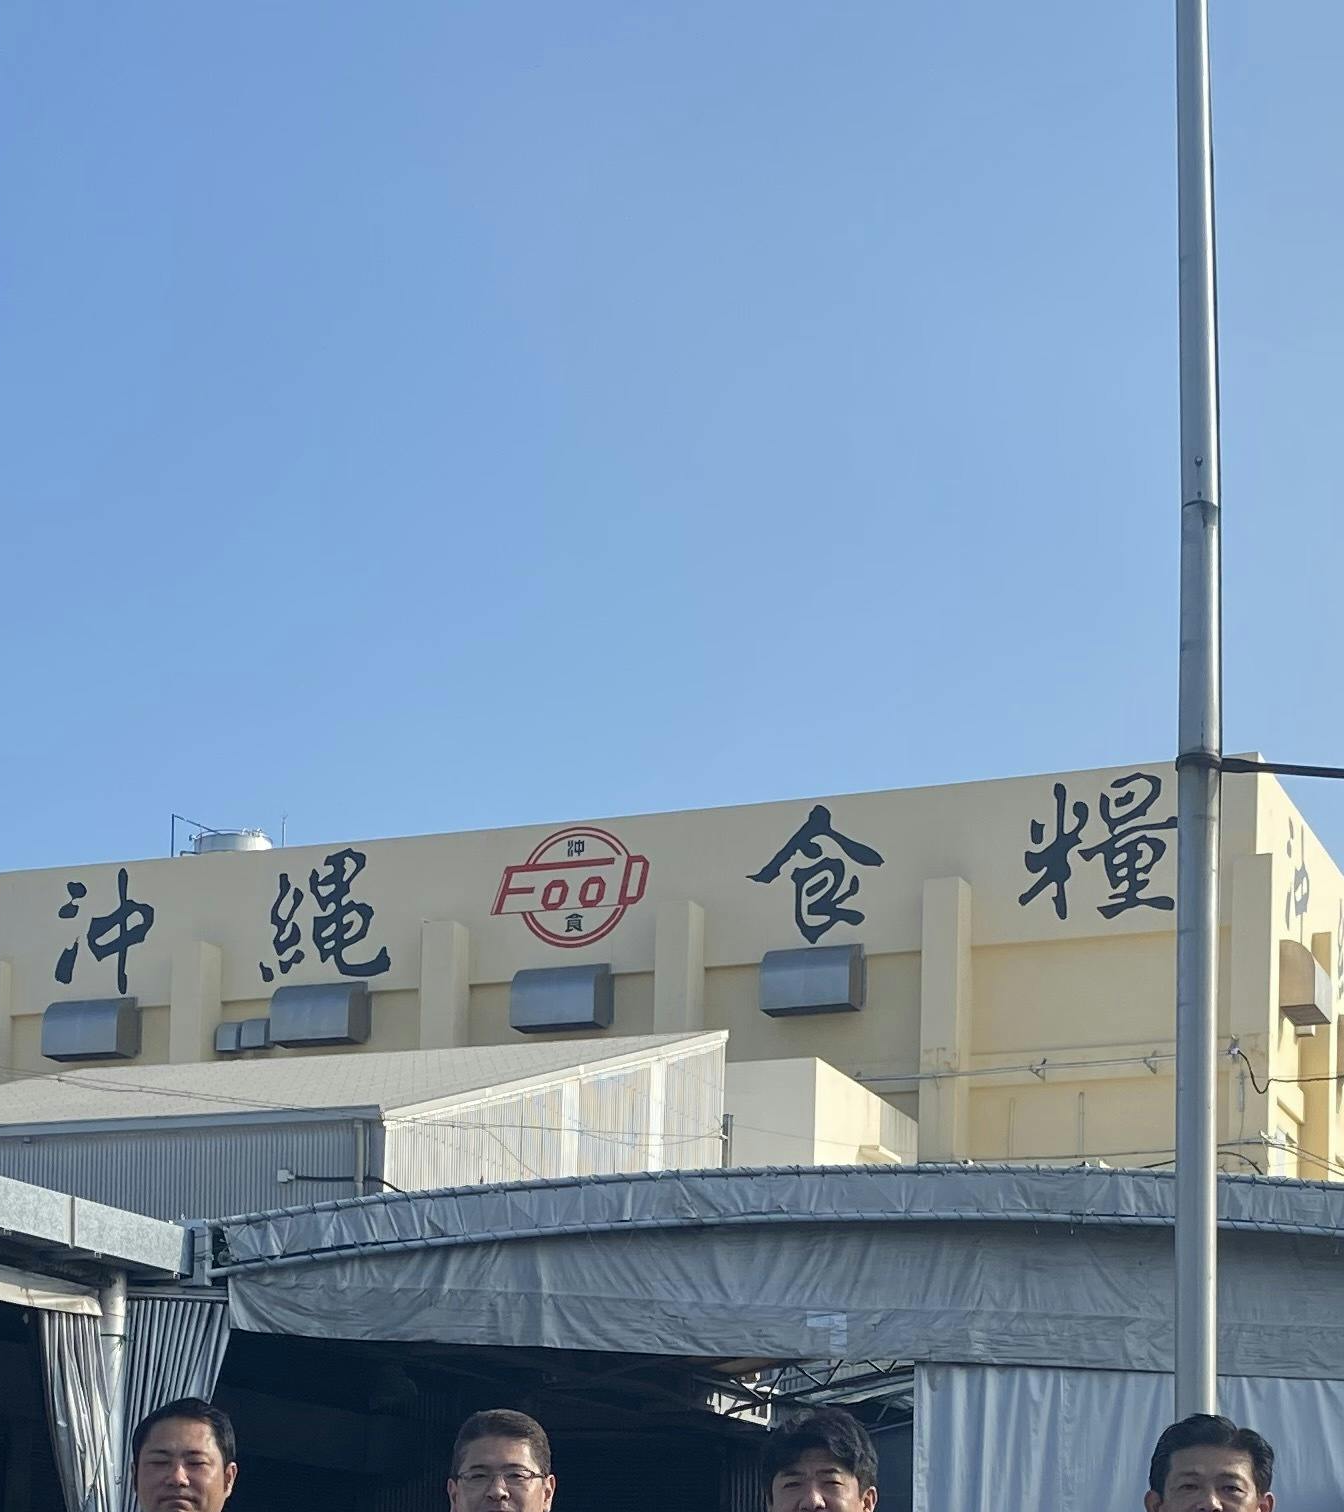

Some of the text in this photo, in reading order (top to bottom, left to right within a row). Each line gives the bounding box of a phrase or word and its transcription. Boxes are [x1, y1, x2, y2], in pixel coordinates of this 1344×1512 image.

[54, 772, 1178, 995] 沖縄 食糧
[564, 912, 585, 932] 食
